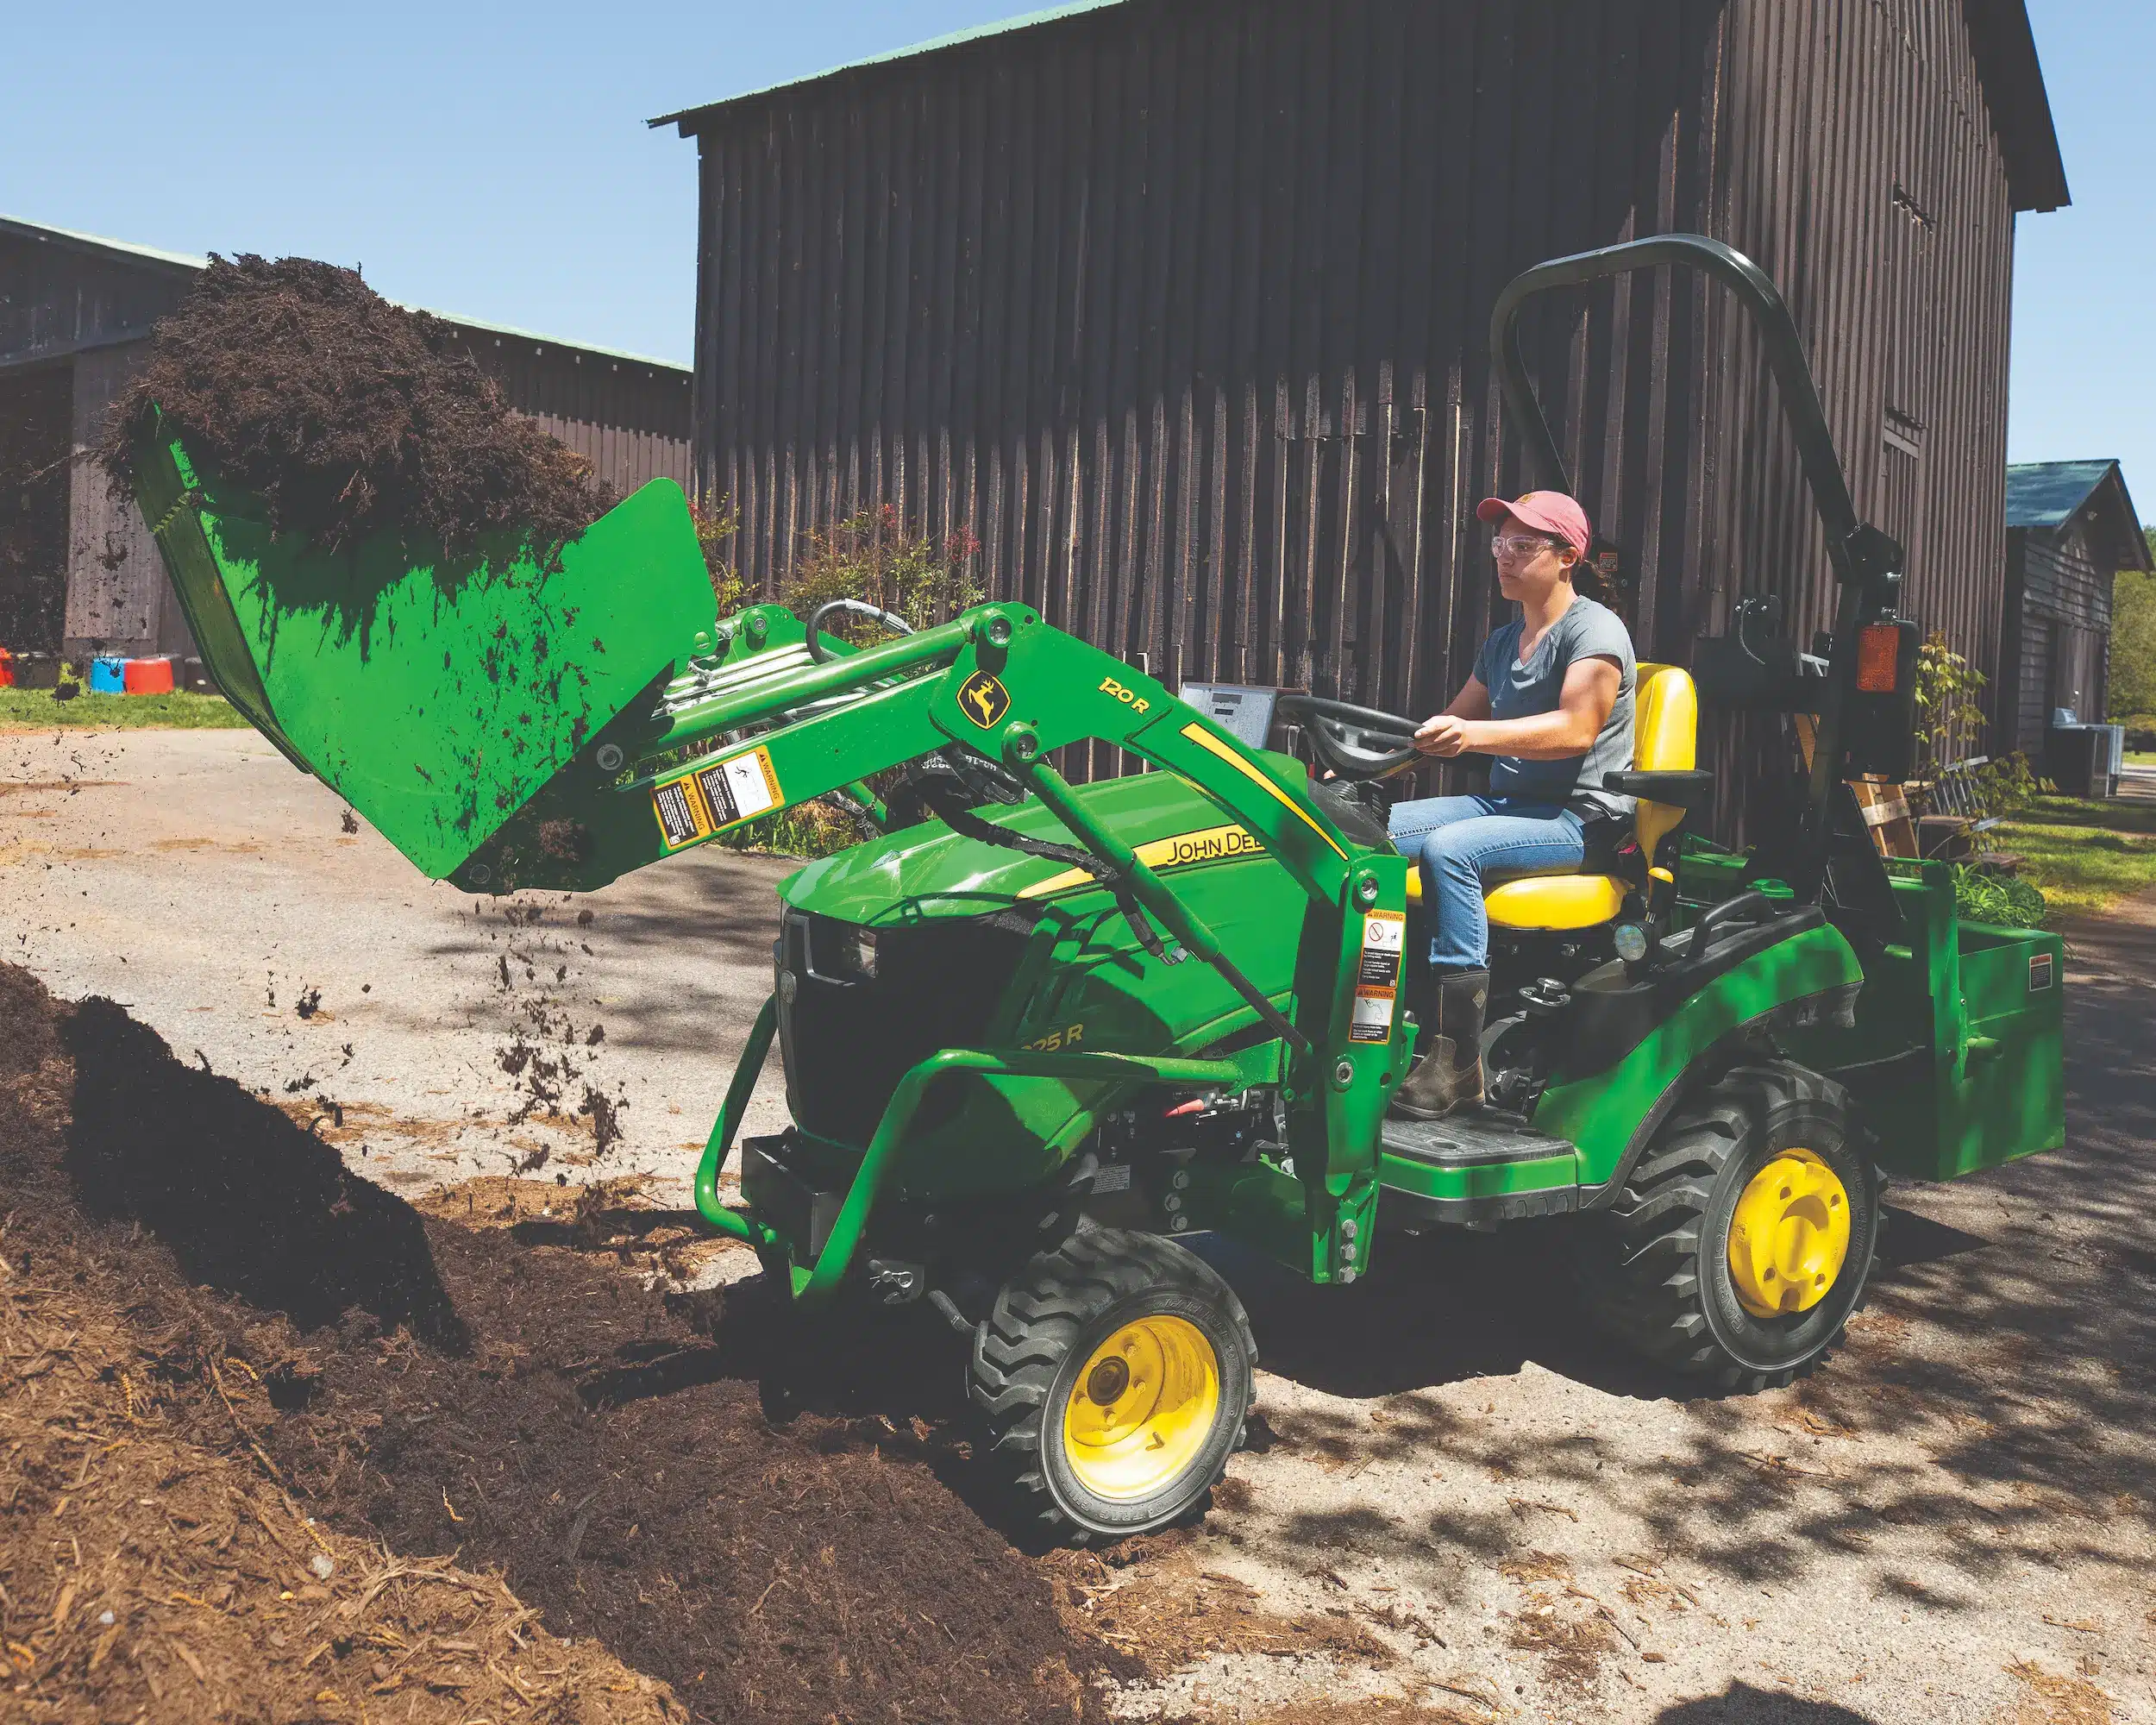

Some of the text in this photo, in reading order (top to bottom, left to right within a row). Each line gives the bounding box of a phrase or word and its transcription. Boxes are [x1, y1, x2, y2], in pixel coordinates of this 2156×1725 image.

[763, 762, 780, 800] WARNING
[688, 793, 705, 831] WARNING
[1167, 838, 1222, 862] JOHN
[1372, 910, 1404, 921] WARNING
[1363, 988, 1394, 999] WARNING
[1058, 1472, 1093, 1512] CHIEF
